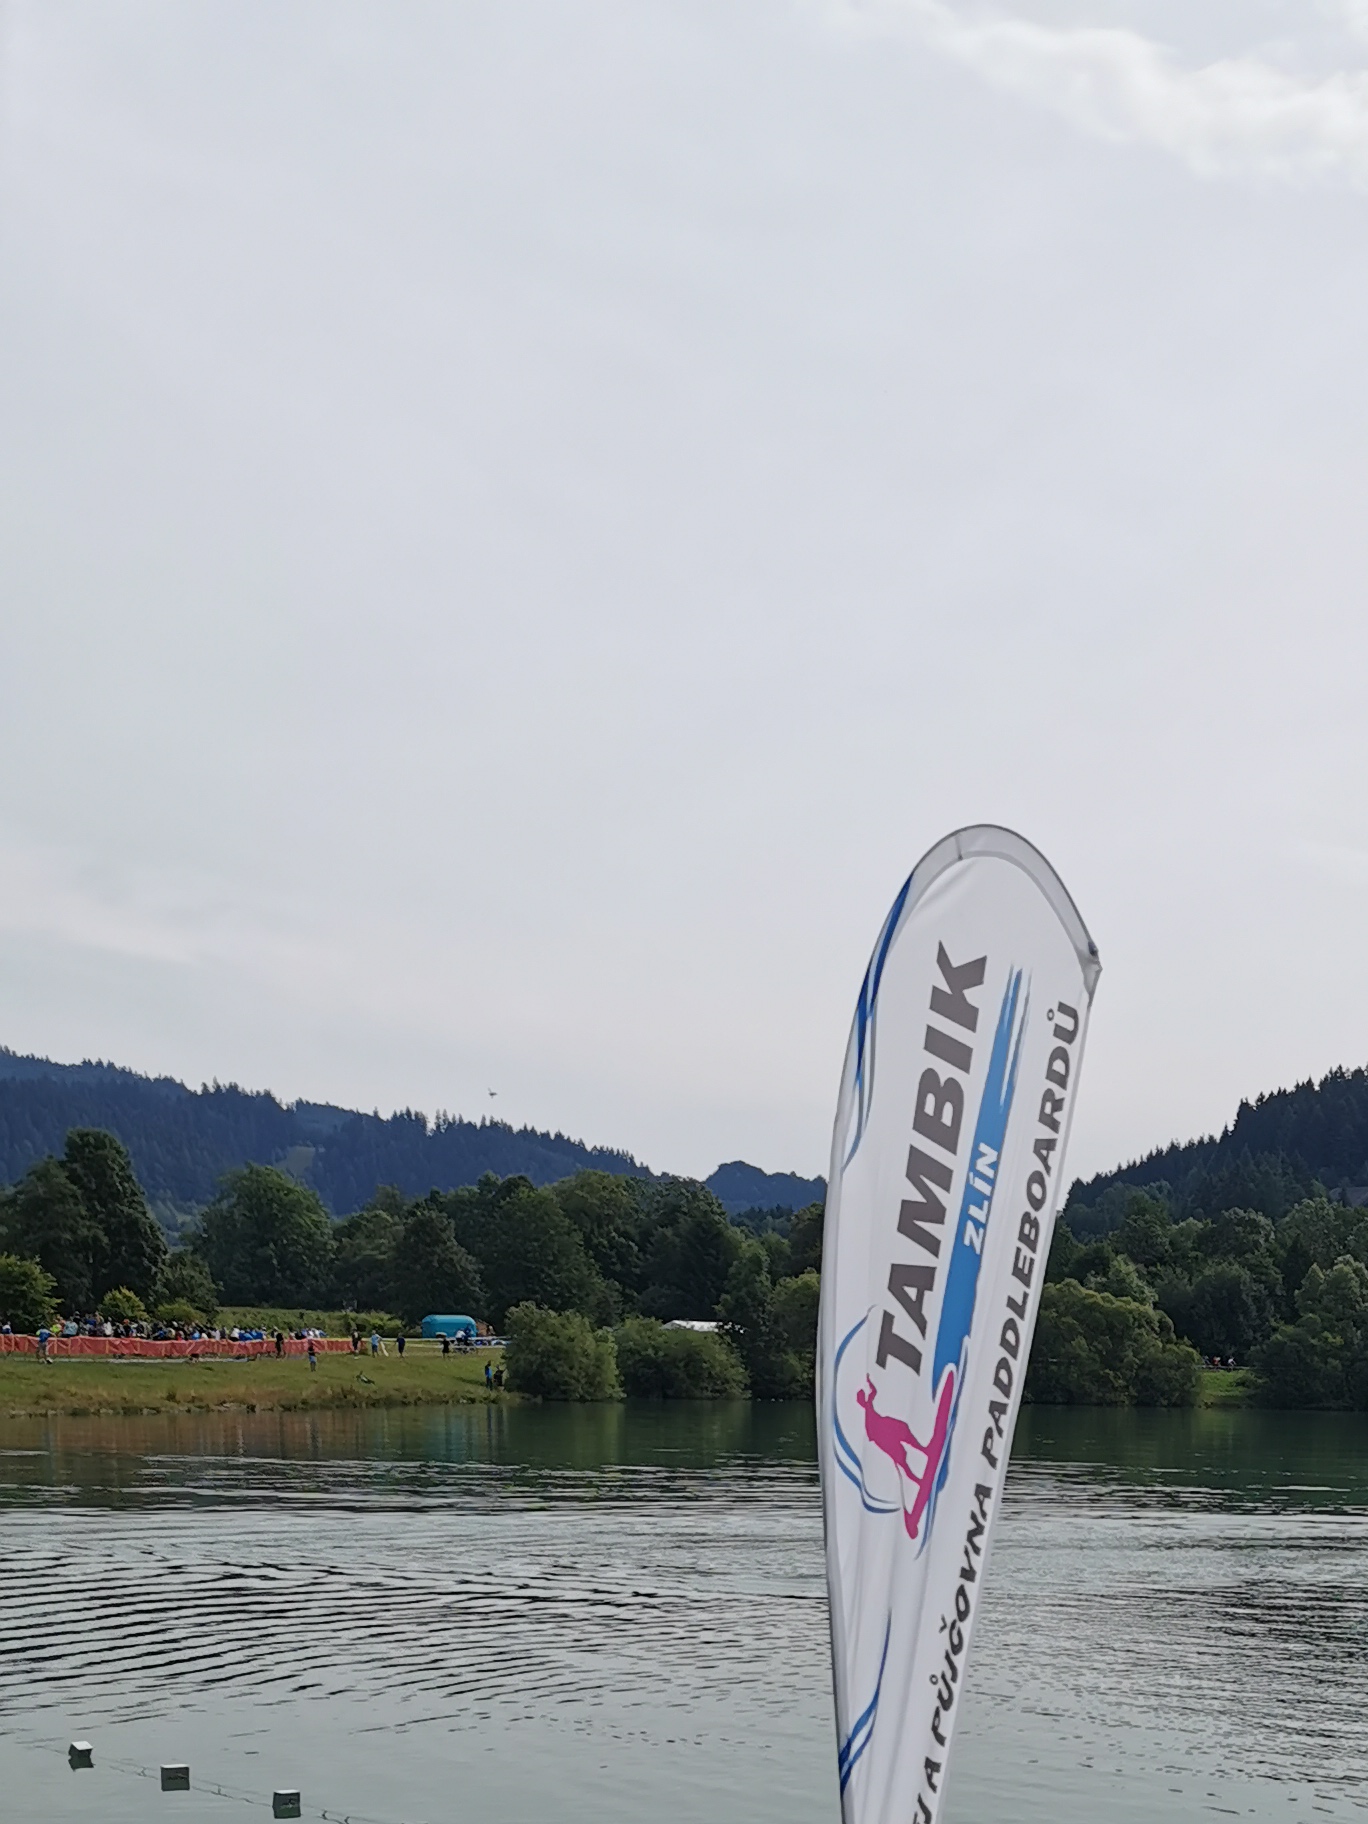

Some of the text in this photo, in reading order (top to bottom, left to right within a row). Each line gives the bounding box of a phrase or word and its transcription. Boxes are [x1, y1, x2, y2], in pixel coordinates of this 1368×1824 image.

[875, 940, 987, 1377] TAMBIK
[963, 1142, 1000, 1256] ZLÍN
[981, 1000, 1080, 1470] PADDLEBOARDŮ
[929, 1483, 993, 1747] PŮJČOVNA
[922, 1757, 944, 1793] A
